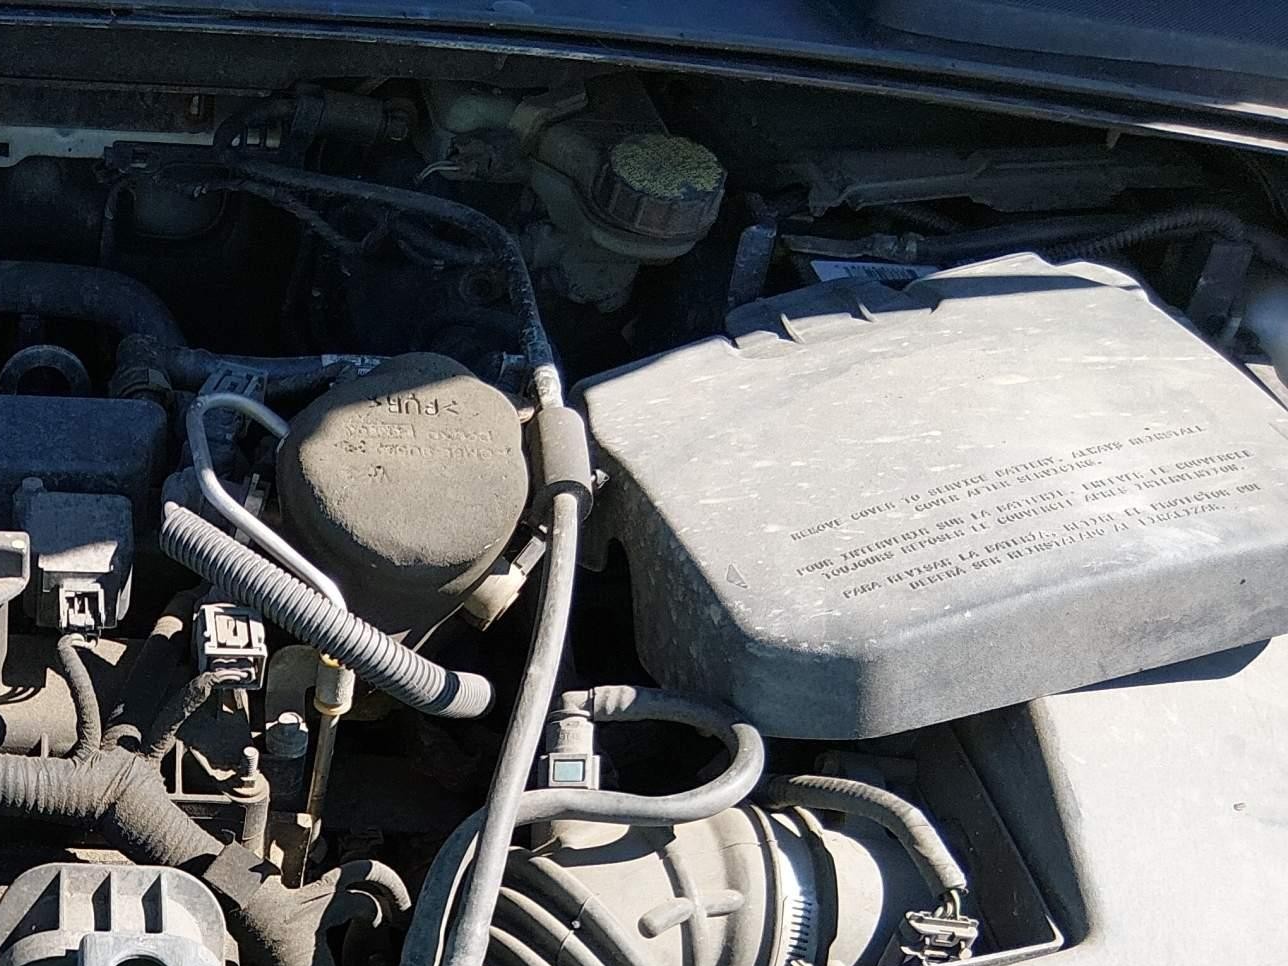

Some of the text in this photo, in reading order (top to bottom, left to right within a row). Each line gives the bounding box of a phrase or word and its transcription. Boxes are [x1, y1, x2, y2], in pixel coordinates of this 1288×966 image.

[849, 501, 896, 521] COVER
[900, 493, 921, 505] TO
[926, 474, 986, 496] SERVICE
[914, 493, 959, 512] COVER
[935, 516, 964, 531] SUR
